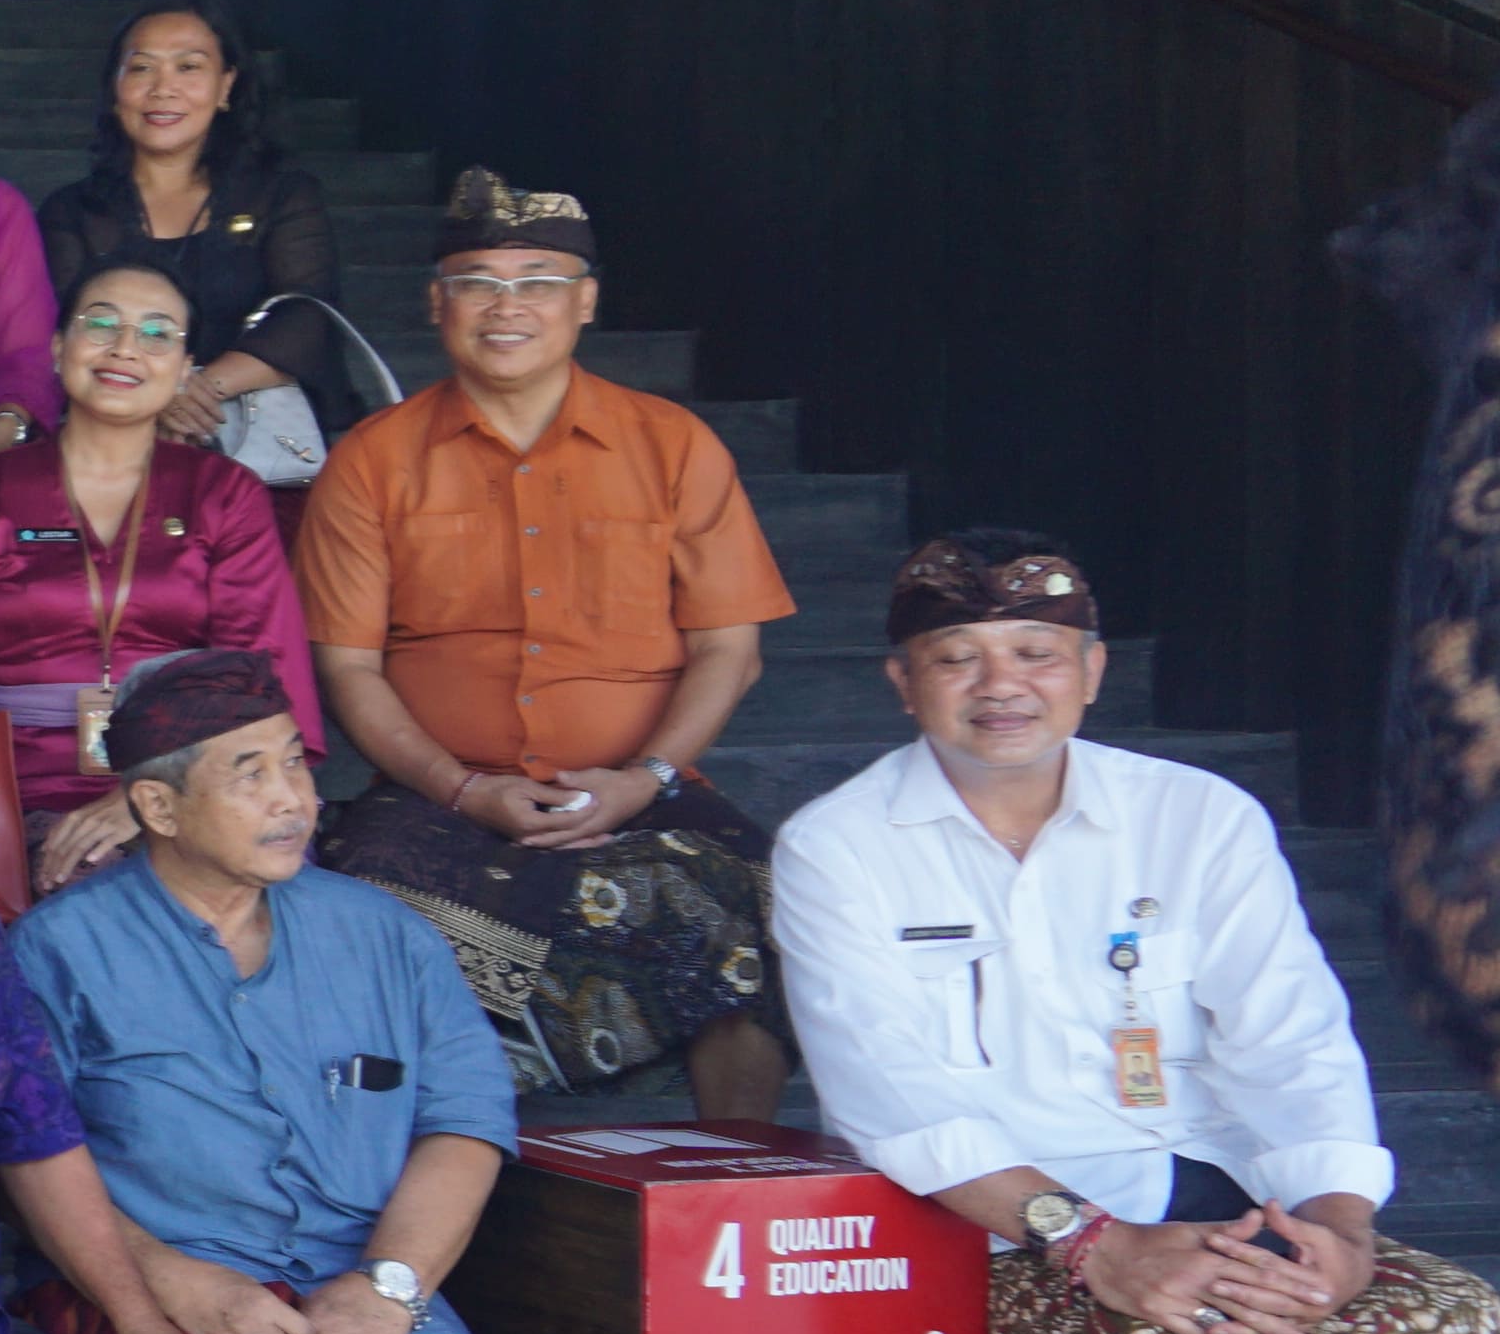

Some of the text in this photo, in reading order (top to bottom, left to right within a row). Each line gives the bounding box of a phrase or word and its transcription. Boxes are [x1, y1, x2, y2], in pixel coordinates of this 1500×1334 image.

[769, 1216, 875, 1254] QUALITY
[704, 1222, 745, 1299] 4
[769, 1258, 909, 1297] EDUCATION
